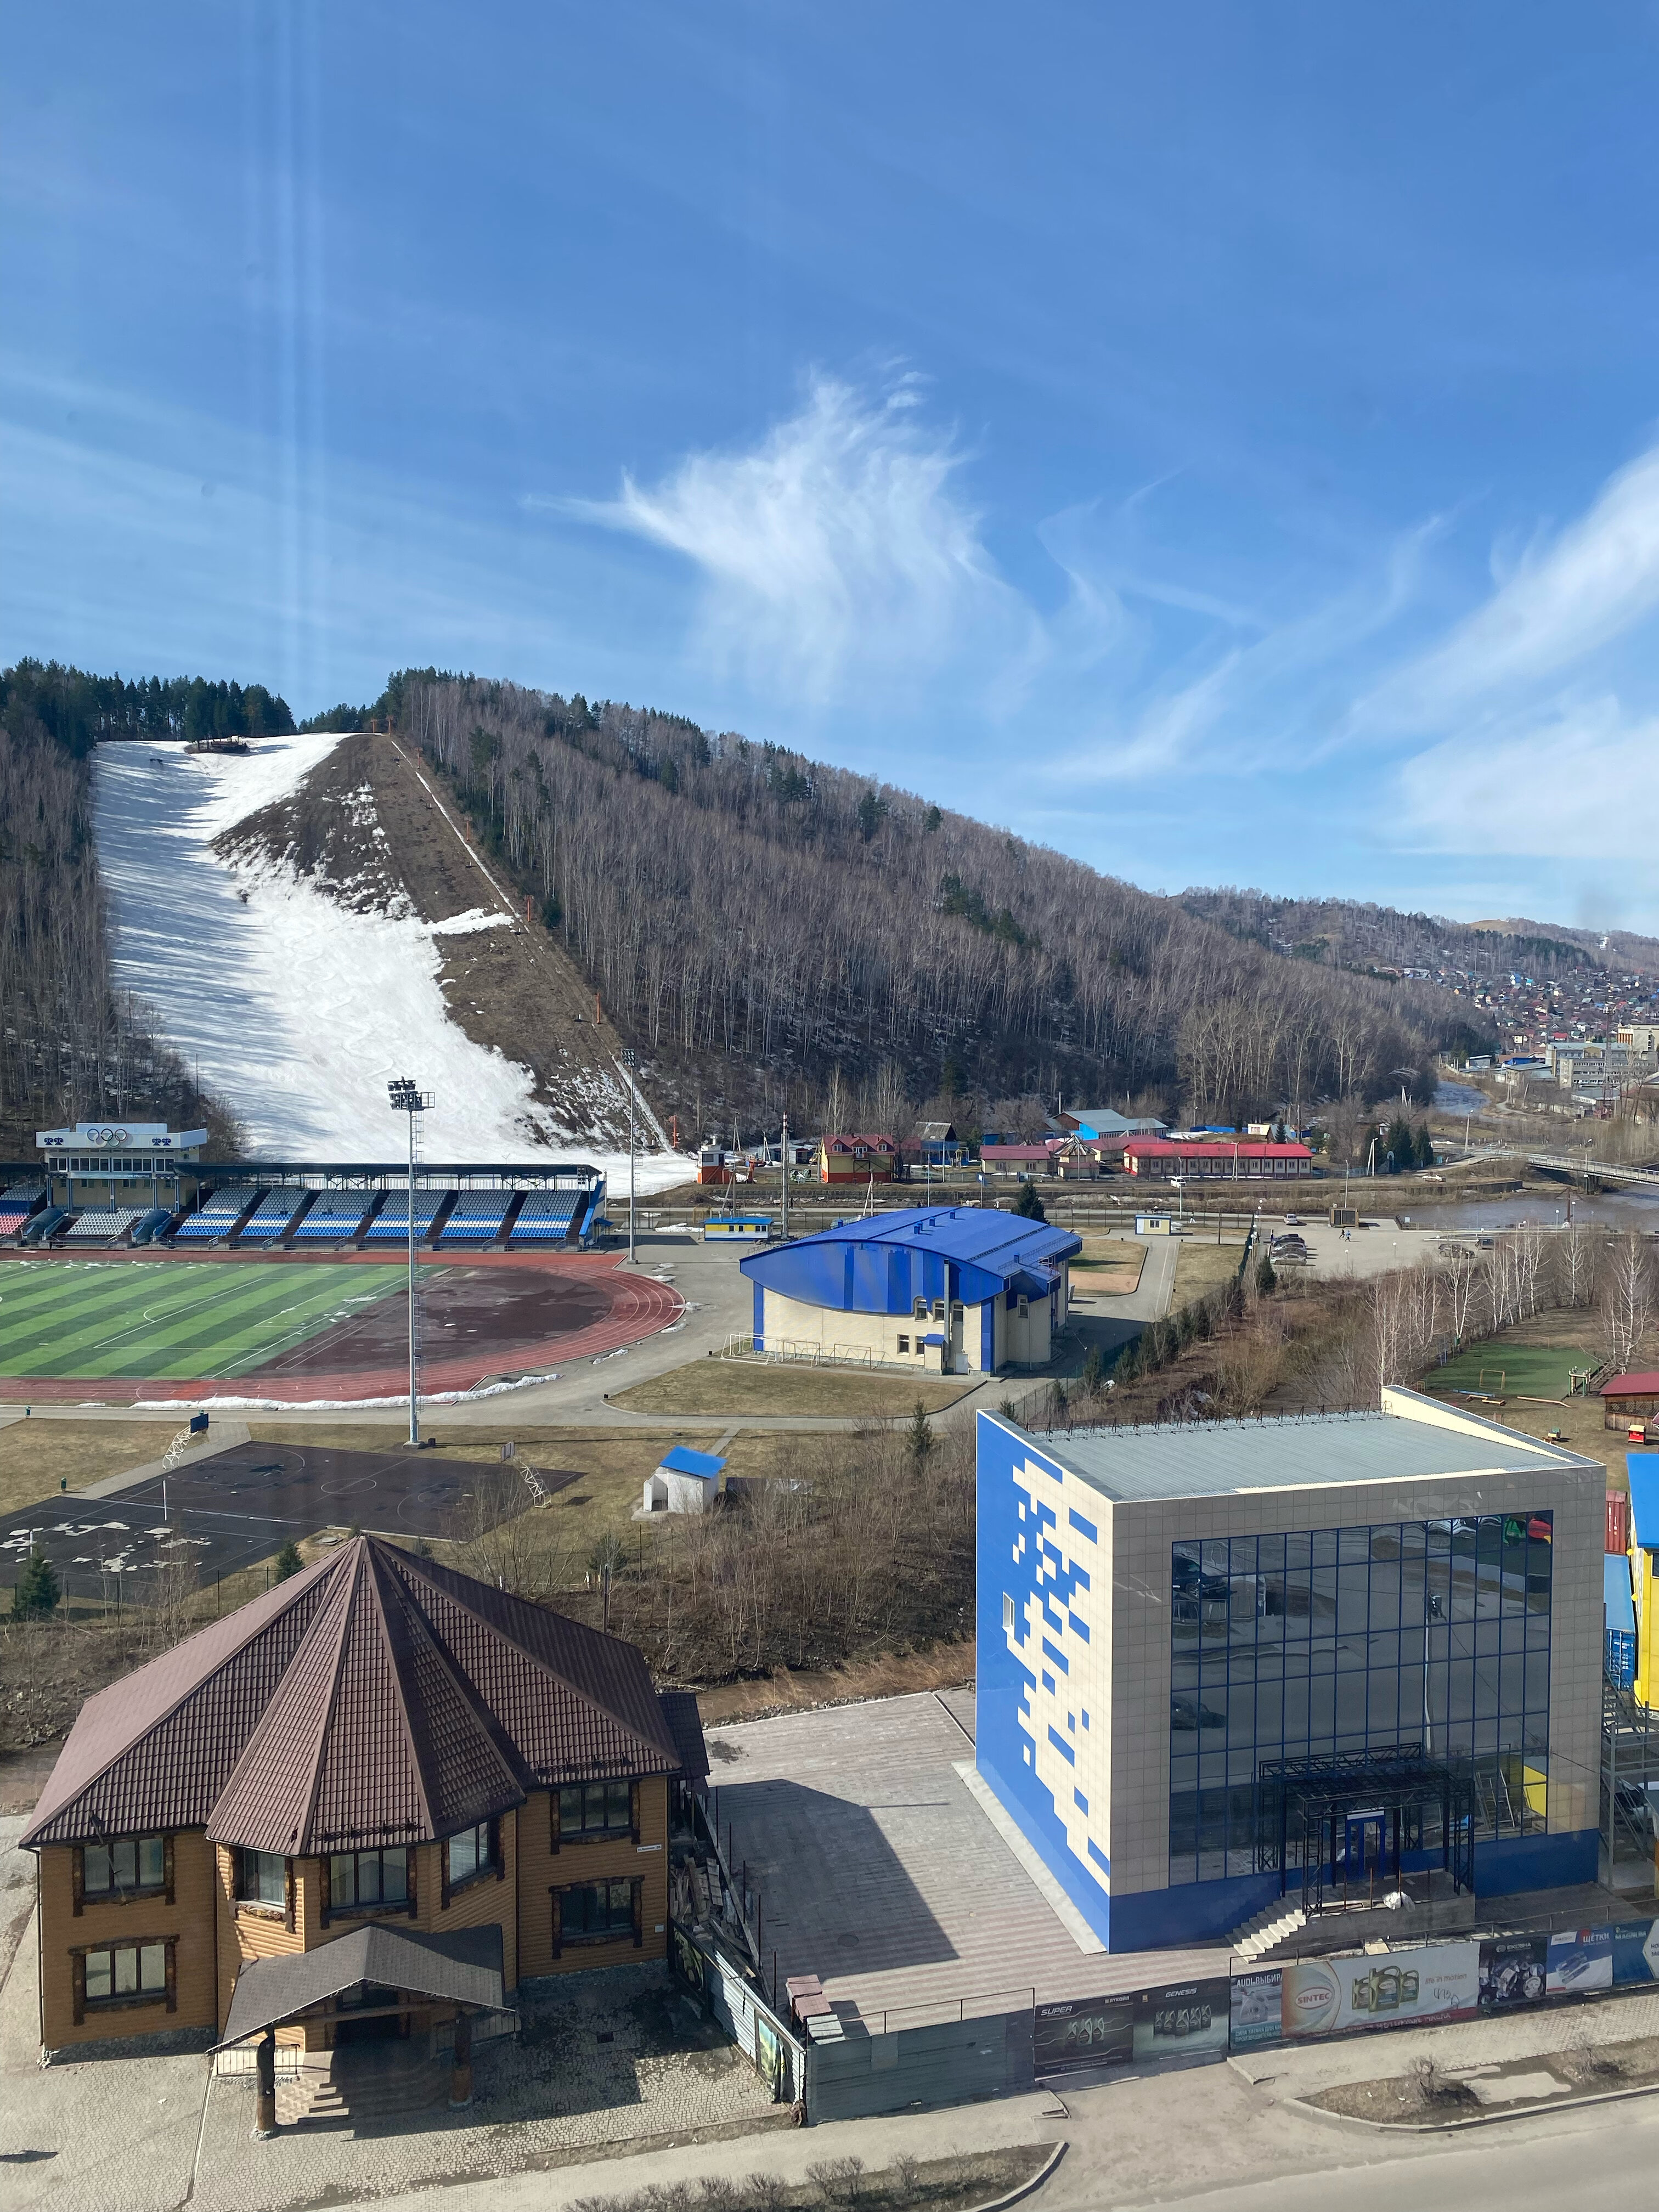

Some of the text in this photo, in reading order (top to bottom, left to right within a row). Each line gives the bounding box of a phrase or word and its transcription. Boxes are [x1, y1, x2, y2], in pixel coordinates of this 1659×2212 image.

[1583, 1932, 1609, 1943] ЩЁТКИ
[1444, 1973, 1467, 1982] motion
[1165, 1988, 1197, 1997] GENESIS
[1297, 1993, 1330, 2004] SINTEC
[1041, 2006, 1073, 2016] SUPER
